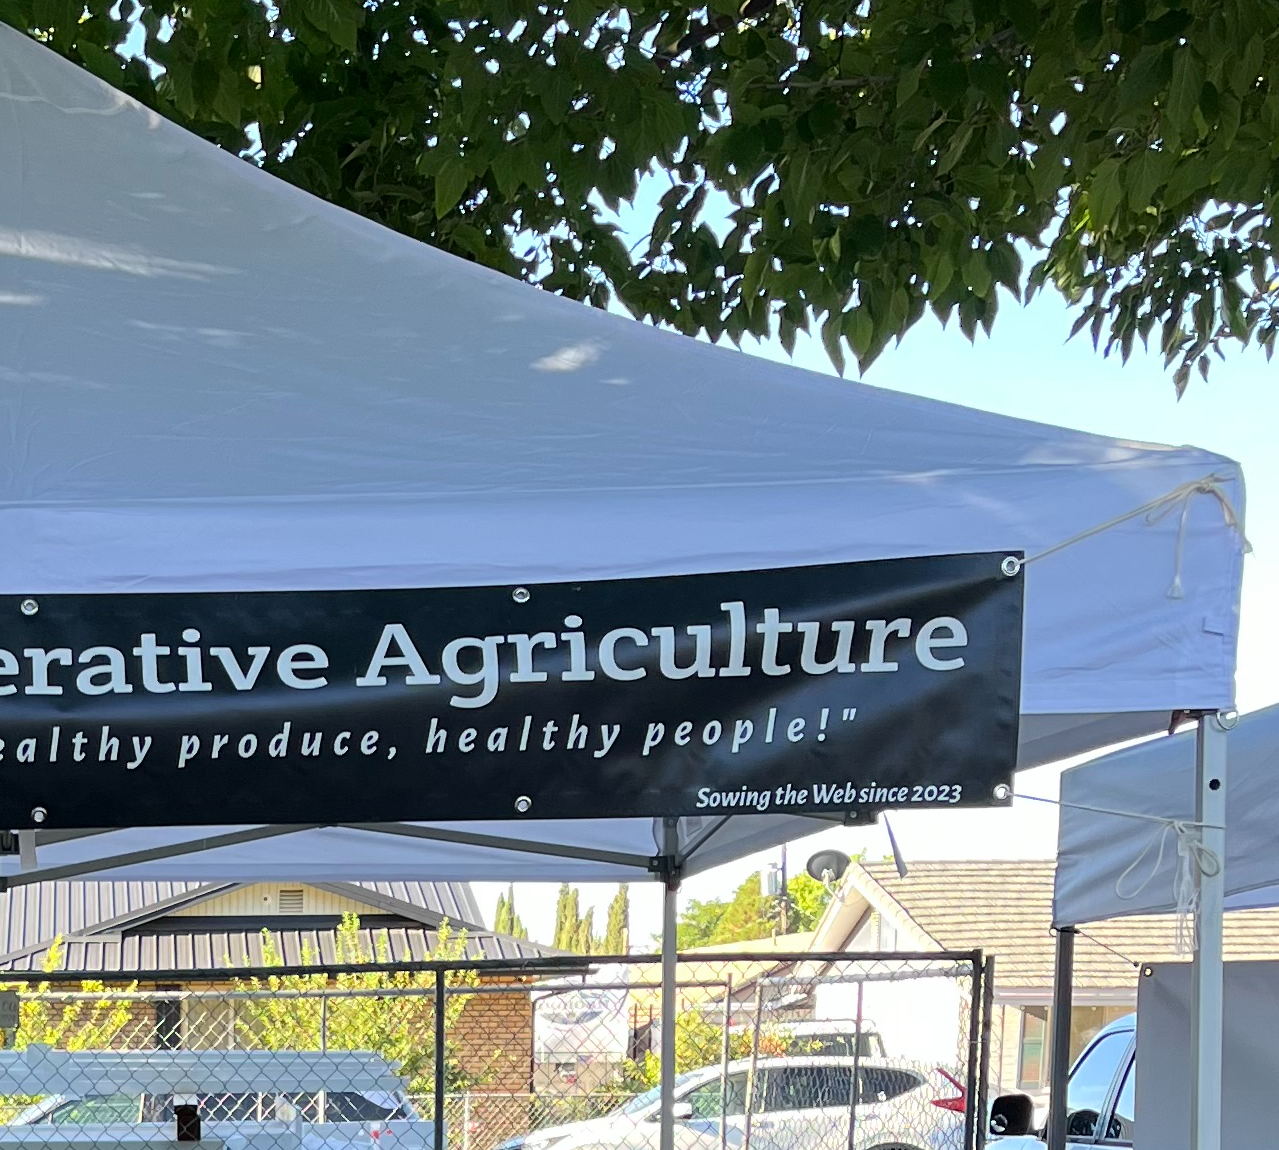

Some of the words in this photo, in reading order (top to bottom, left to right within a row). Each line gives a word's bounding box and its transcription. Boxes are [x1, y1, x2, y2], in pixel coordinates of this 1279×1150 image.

[356, 599, 968, 709] Agriculture
[178, 722, 397, 769] produce,
[425, 714, 621, 758] healthy
[642, 707, 857, 756] people!"
[695, 786, 772, 811] Sowing
[775, 783, 809, 805] the
[812, 782, 857, 804] Web
[858, 781, 909, 803] since
[910, 784, 963, 804] 2023
